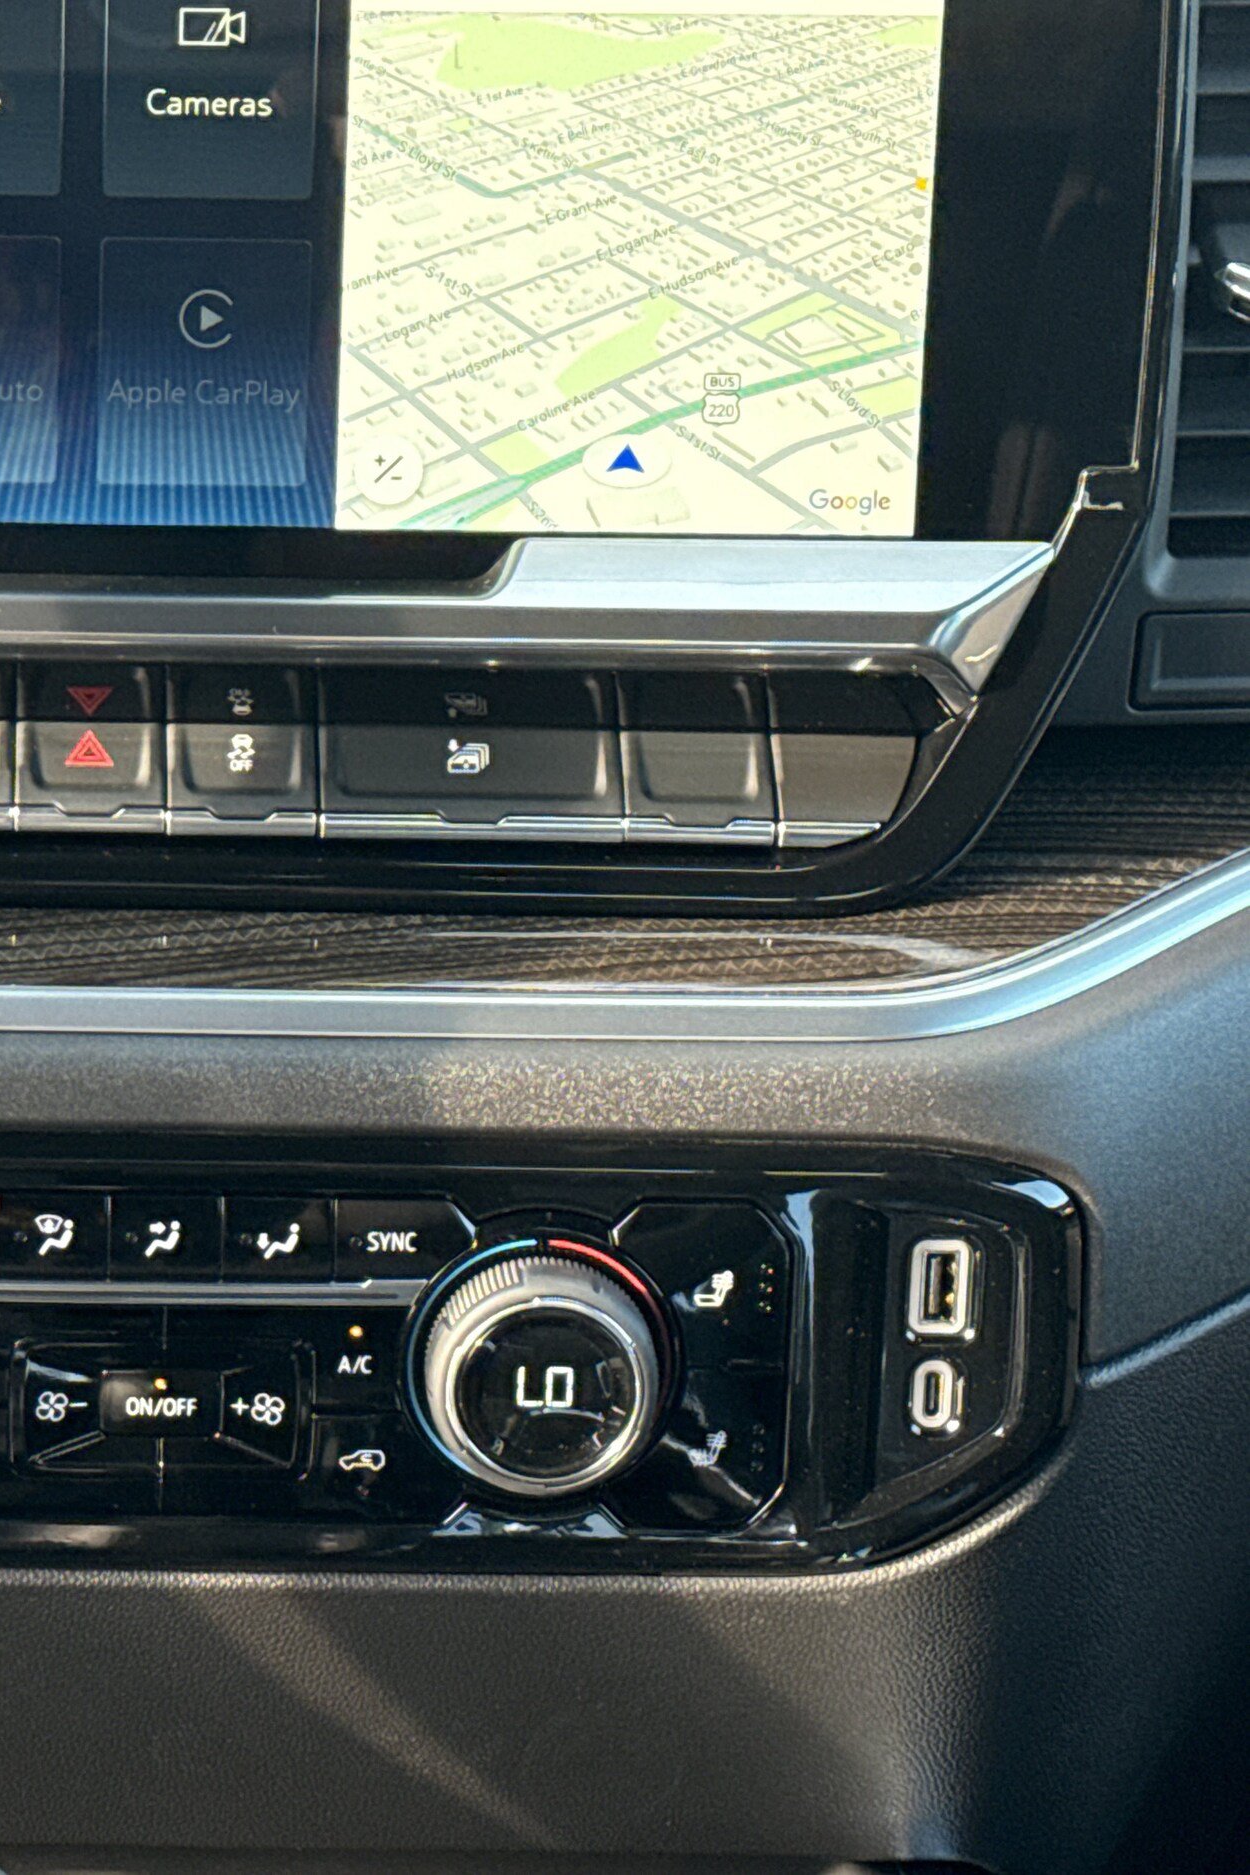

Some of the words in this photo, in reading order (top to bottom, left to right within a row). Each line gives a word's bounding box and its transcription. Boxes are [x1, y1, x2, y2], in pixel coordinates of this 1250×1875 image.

[146, 90, 273, 117] Cameras
[476, 94, 484, 105] E
[487, 91, 502, 102] 1st
[505, 87, 523, 97] Ave
[592, 123, 611, 134] Ave
[846, 124, 881, 144] South
[886, 138, 896, 150] St
[372, 150, 393, 162] Ave
[398, 141, 408, 152] S
[409, 147, 442, 173] Lloyd
[442, 165, 456, 181] St
[708, 153, 721, 166] St
[545, 213, 553, 225] E
[556, 203, 588, 222] Grant
[593, 194, 618, 210] Ave
[596, 248, 605, 261] E
[608, 233, 650, 257] Logan
[653, 223, 677, 239] Ave
[872, 255, 881, 267] E
[376, 267, 398, 282] Ave
[425, 266, 435, 279] S
[436, 272, 457, 291] 1st
[458, 284, 473, 298] St
[648, 286, 657, 299] E
[660, 267, 712, 294] Hudson
[715, 255, 739, 272] Ave
[384, 319, 425, 343] Logan
[428, 309, 452, 325] Ave
[447, 356, 498, 381] Hudson
[501, 343, 525, 358] Ave
[108, 378, 188, 409] Apple
[196, 381, 300, 413] CarPlay
[710, 377, 735, 388] BUS
[517, 404, 570, 431] Caroline
[573, 391, 597, 406] Ave
[709, 404, 734, 417] 220
[830, 381, 840, 392] S
[838, 389, 868, 420] Lloyd
[867, 412, 881, 428] St
[677, 426, 687, 438] S
[688, 432, 708, 452] 1st
[709, 445, 721, 460] St
[809, 489, 891, 515] Google
[230, 760, 253, 772] OFF
[366, 1231, 418, 1252] SYNC
[337, 1354, 372, 1375] A/C
[515, 1366, 574, 1408] LO
[125, 1396, 197, 1418] ON/OFF
